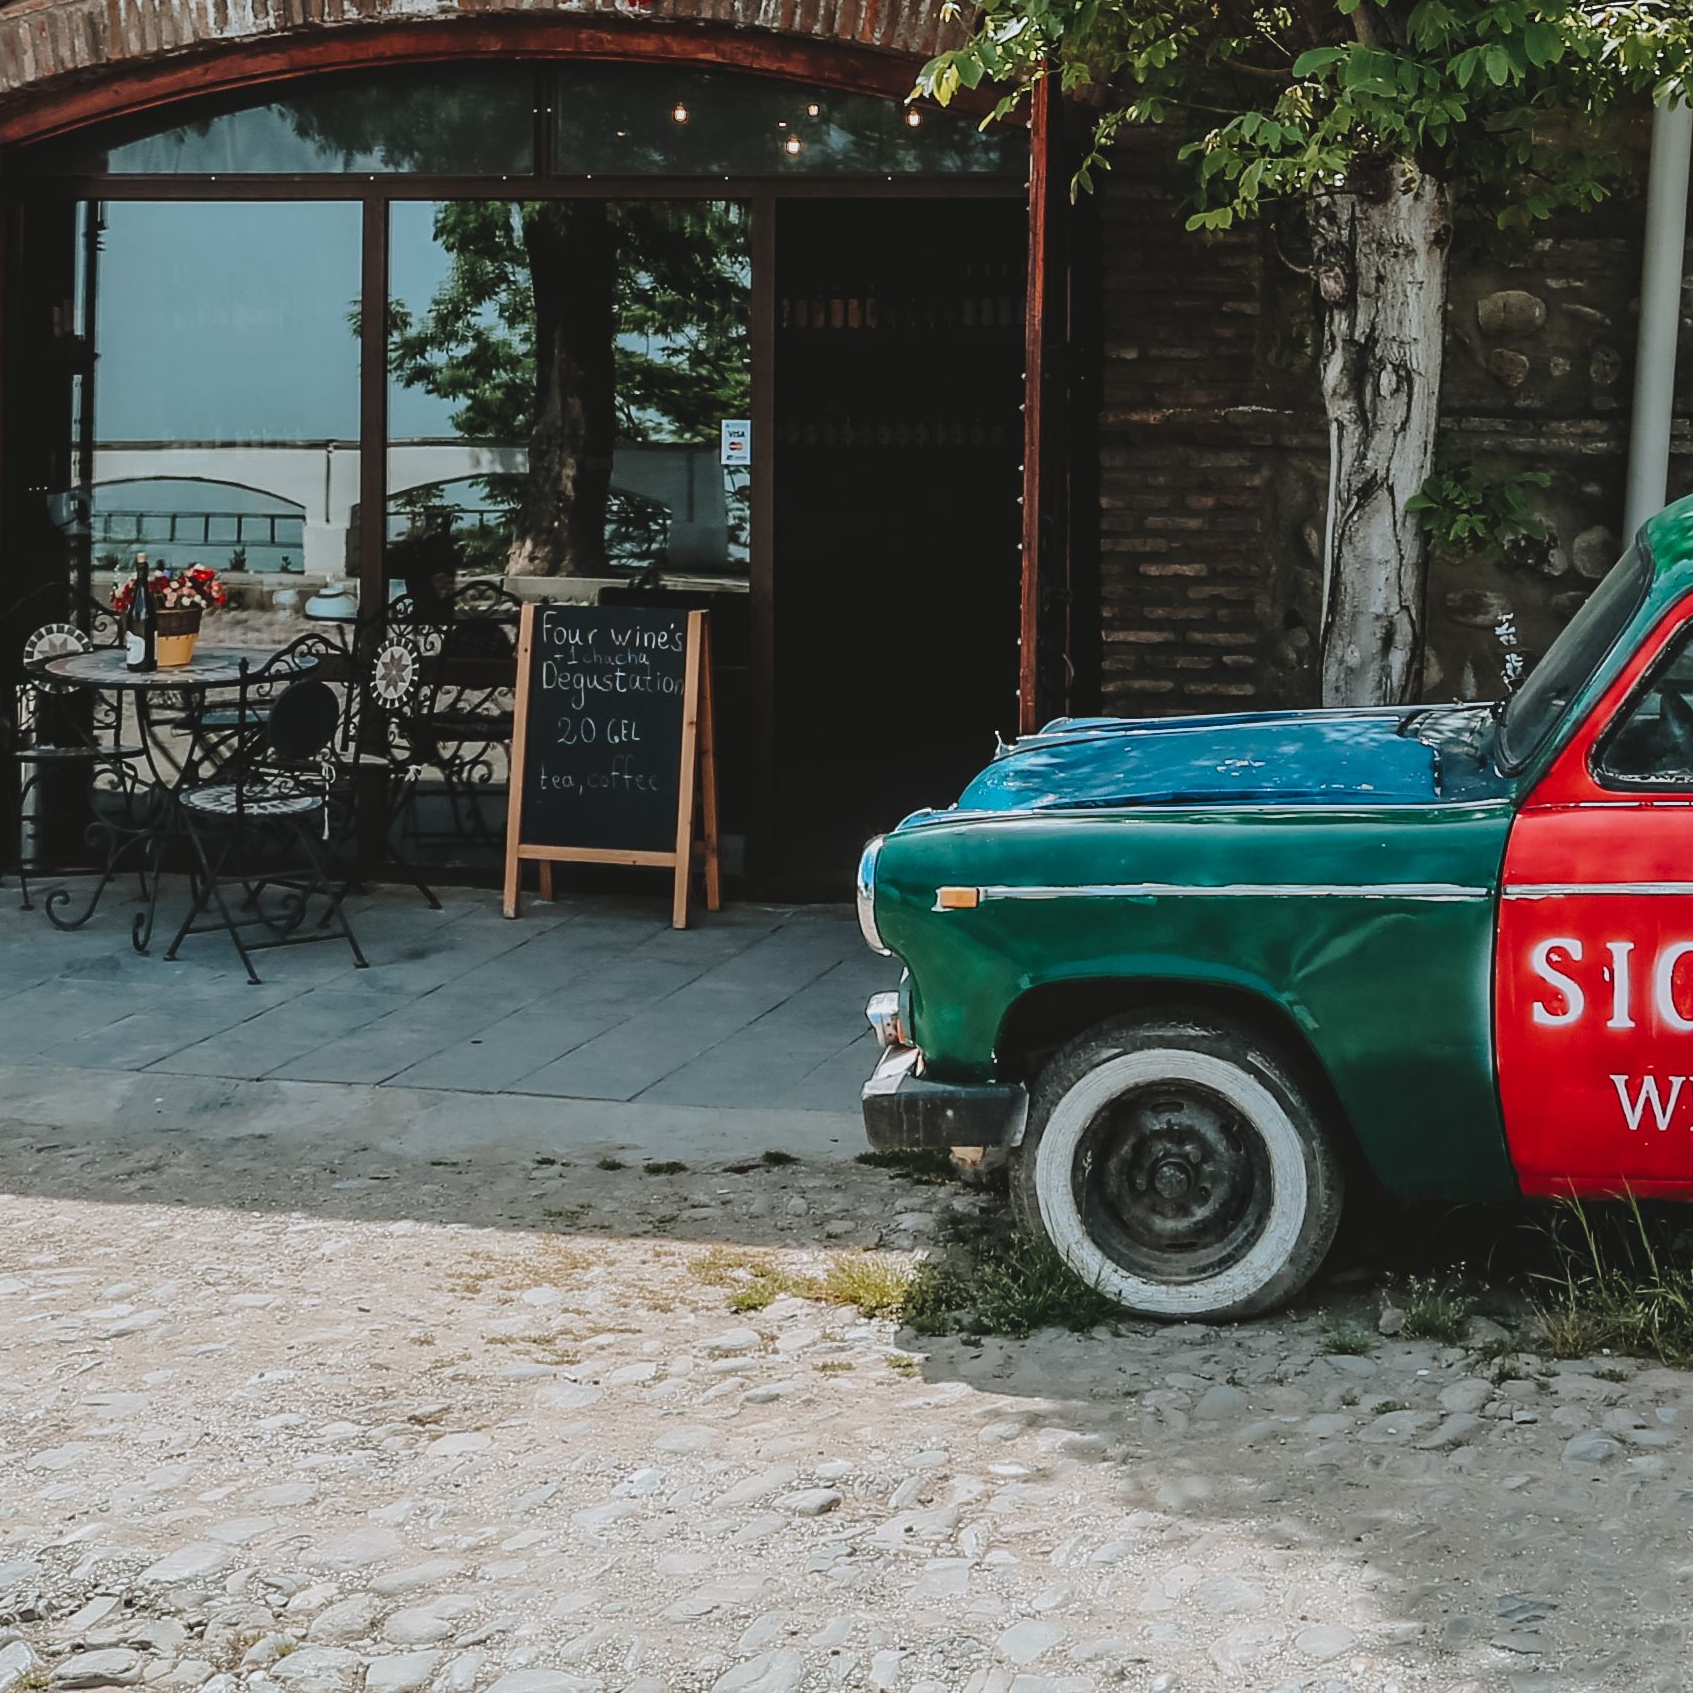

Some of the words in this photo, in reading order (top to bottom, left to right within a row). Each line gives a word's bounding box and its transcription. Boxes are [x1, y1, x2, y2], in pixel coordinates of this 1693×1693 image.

[542, 610, 599, 646] Four
[610, 622, 683, 652] wine's
[582, 648, 650, 666] chacha
[542, 660, 685, 710] Degustation
[557, 717, 597, 745] 20
[607, 718, 641, 744] GEL
